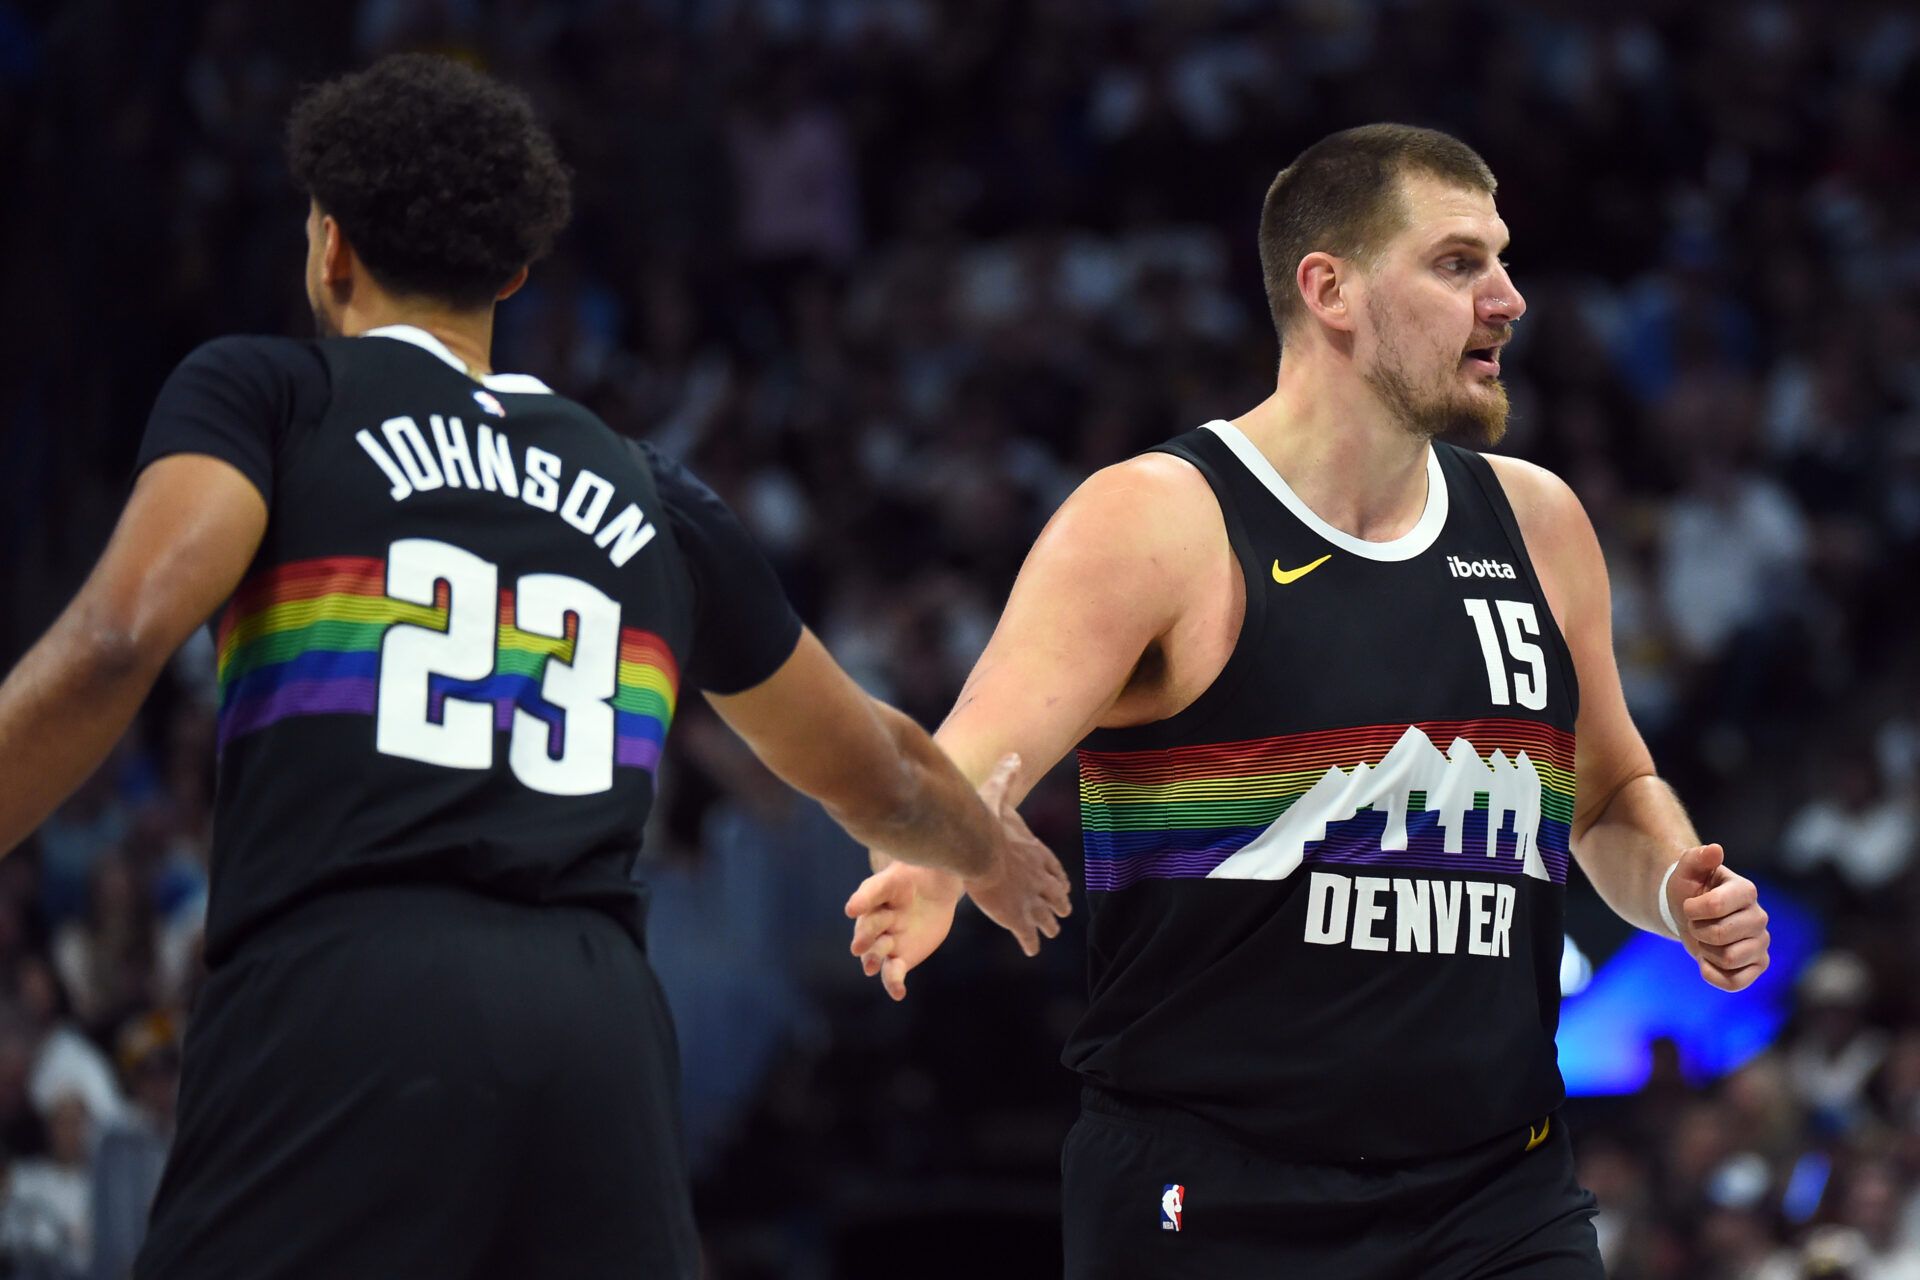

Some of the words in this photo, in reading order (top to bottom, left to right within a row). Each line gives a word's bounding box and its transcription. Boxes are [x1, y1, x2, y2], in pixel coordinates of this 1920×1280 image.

[355, 414, 656, 568] JOHNSON
[1446, 555, 1517, 580] ibotta
[376, 537, 621, 796] 23
[1463, 598, 1548, 711] 15
[1303, 871, 1516, 958] DENVER
